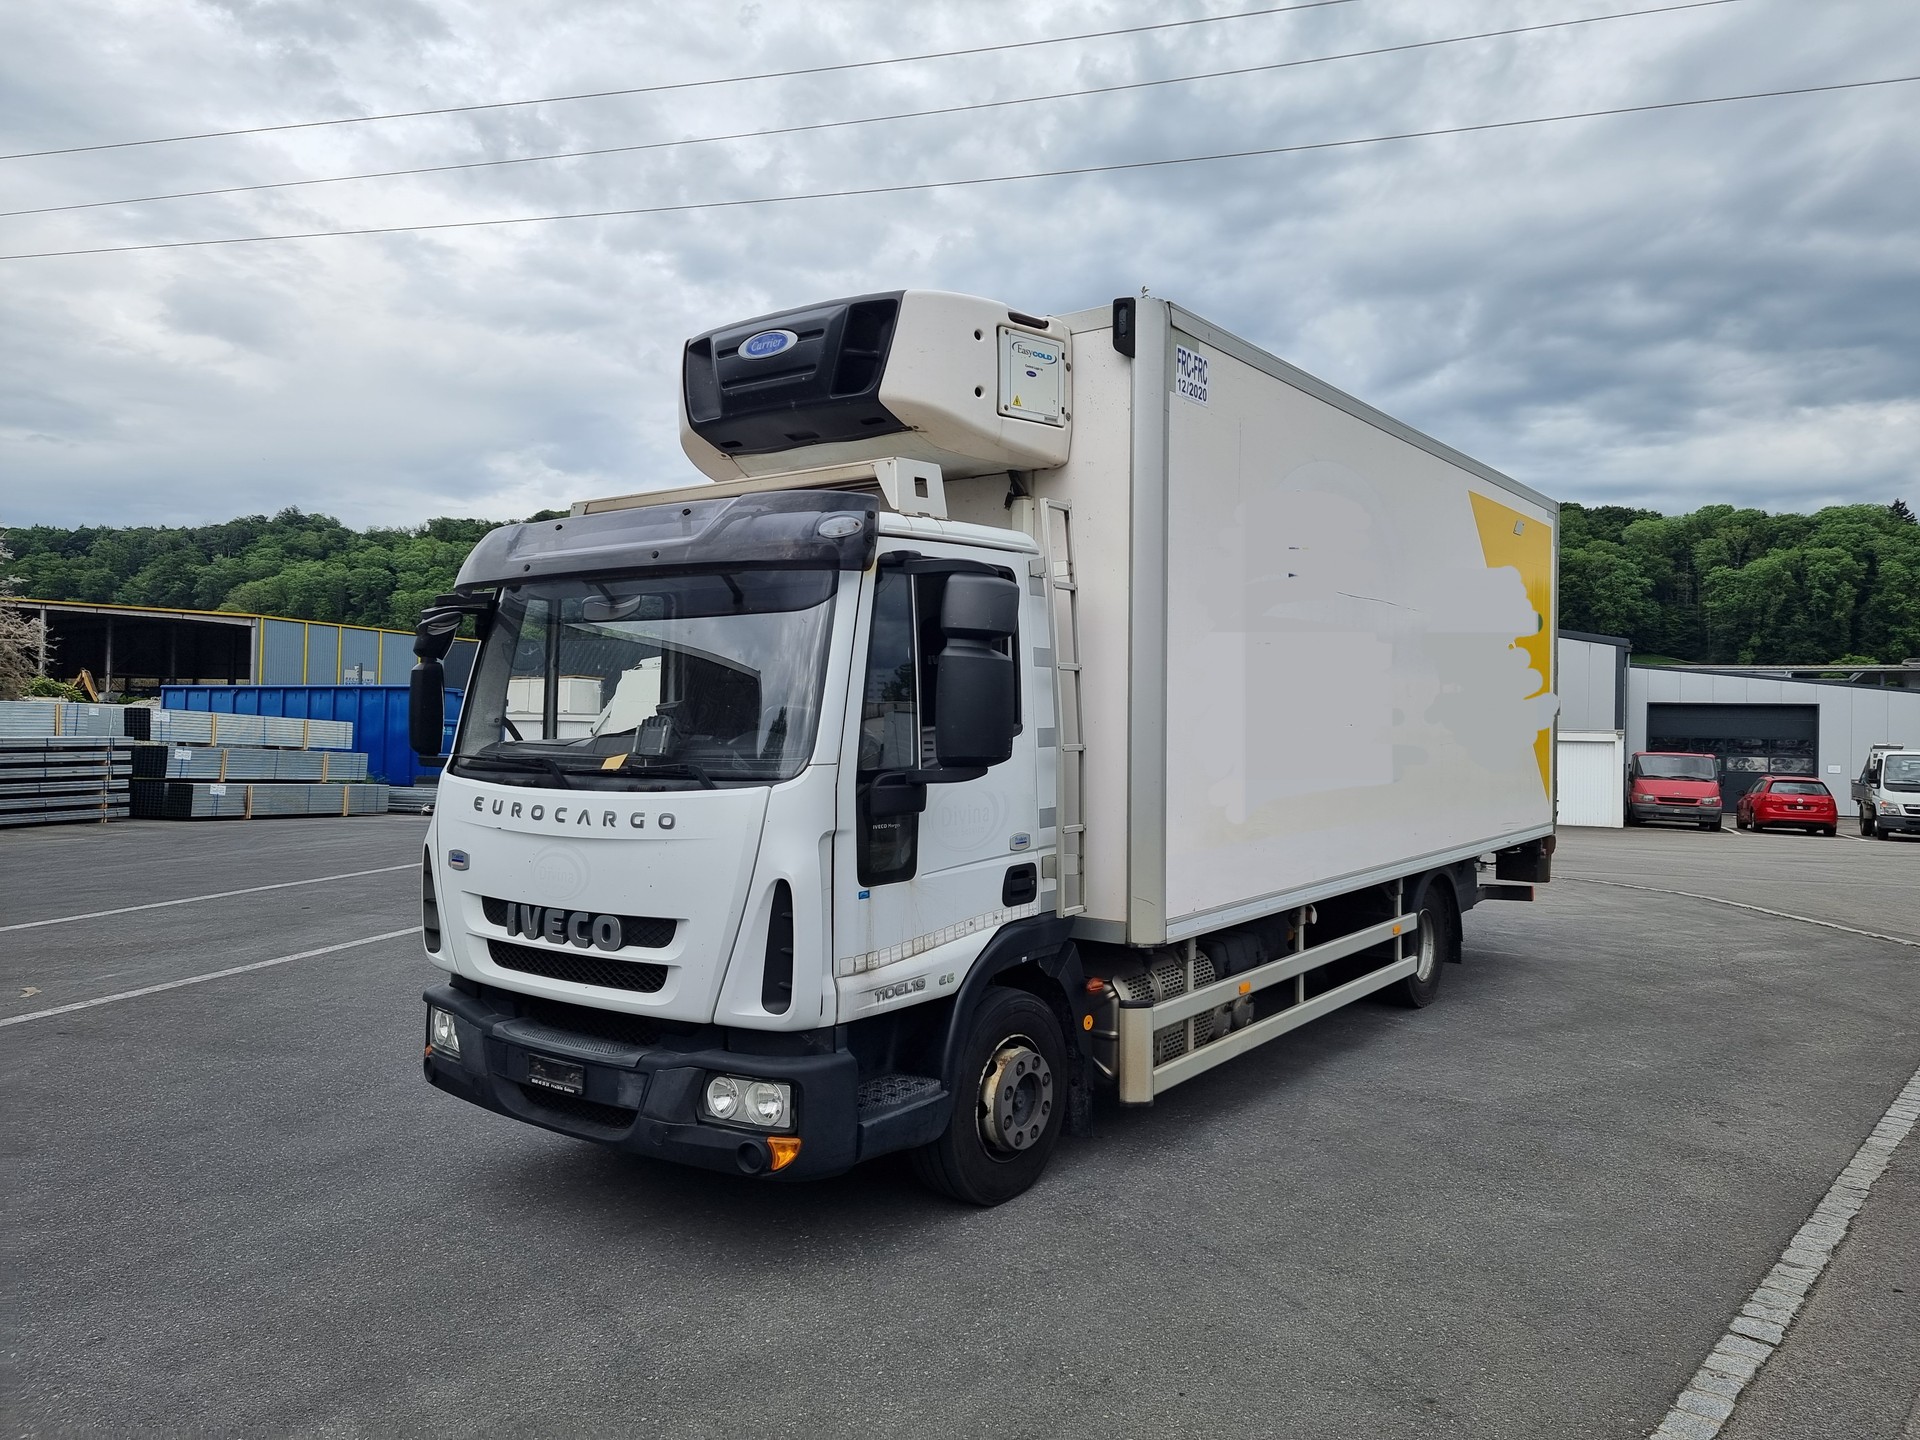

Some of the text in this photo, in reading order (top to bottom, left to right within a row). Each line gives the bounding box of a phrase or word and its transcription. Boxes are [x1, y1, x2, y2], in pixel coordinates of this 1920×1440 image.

[751, 338, 782, 351] Carrier
[1017, 344, 1053, 360] EasyCOLD
[1177, 347, 1208, 386] FRC-FRC
[1177, 378, 1208, 402] 12/2020
[473, 796, 676, 829] EUROCARGO
[506, 903, 624, 951] IVECO
[875, 978, 926, 1003] 110EL19
